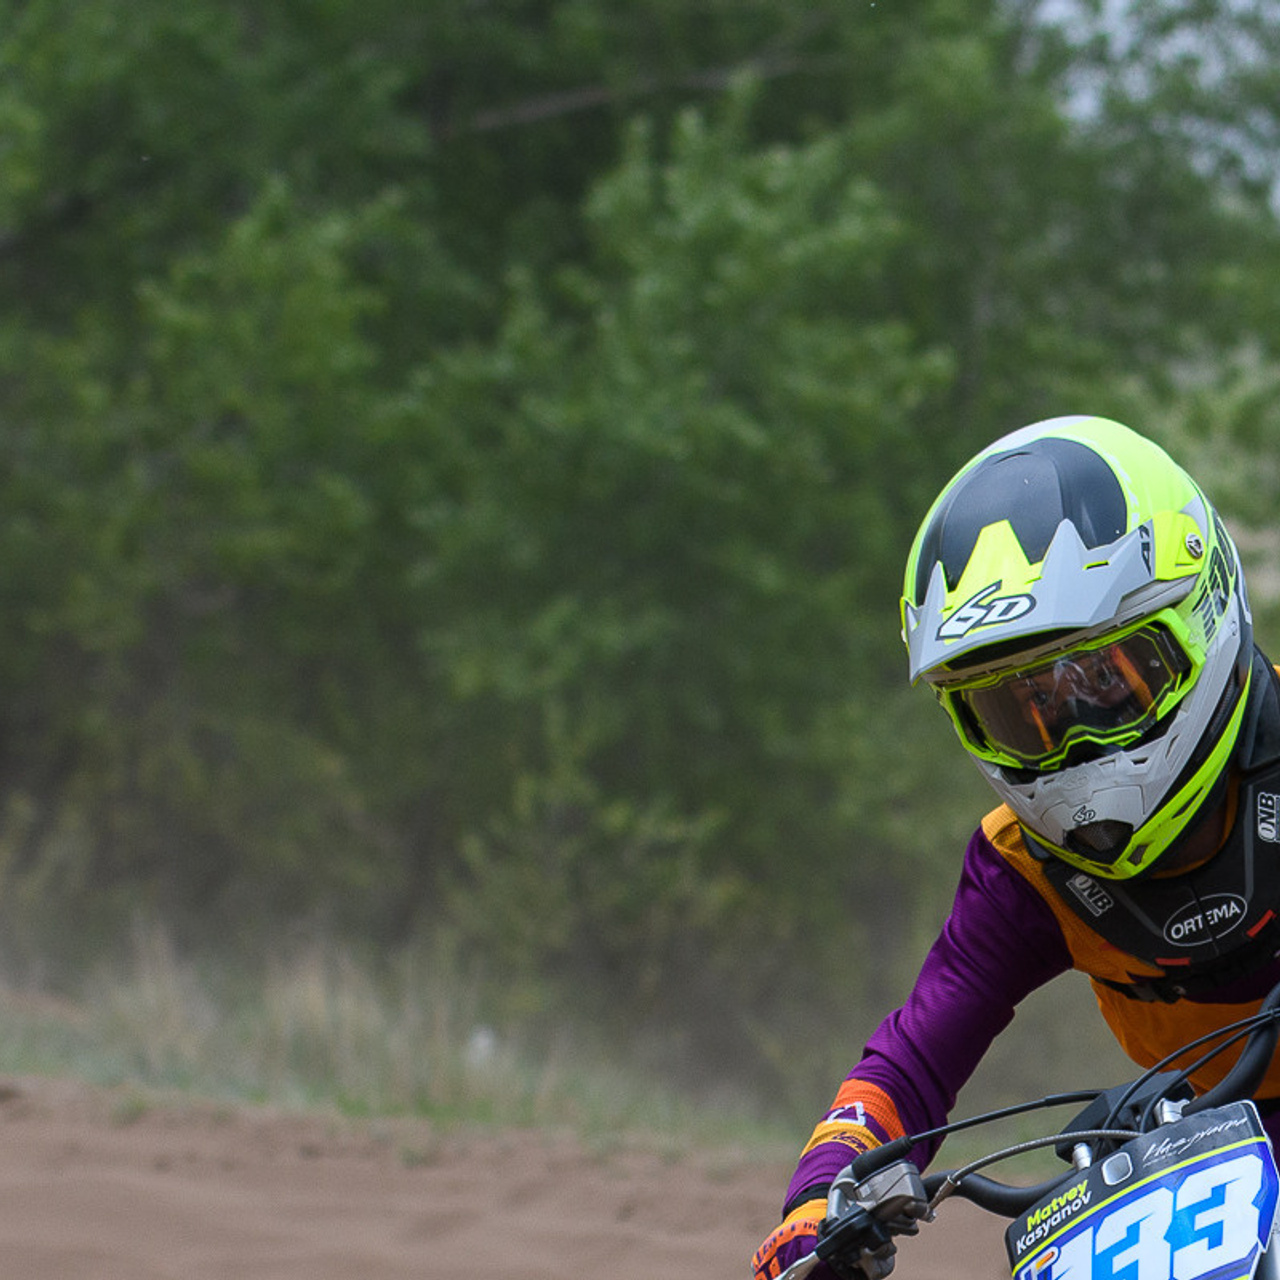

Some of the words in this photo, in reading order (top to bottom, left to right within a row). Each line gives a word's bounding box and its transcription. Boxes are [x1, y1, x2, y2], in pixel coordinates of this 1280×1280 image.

[1171, 900, 1241, 939] ORTEMA
[1016, 1191, 1092, 1256] Kasyanov
[1026, 1179, 1088, 1232] Matvey
